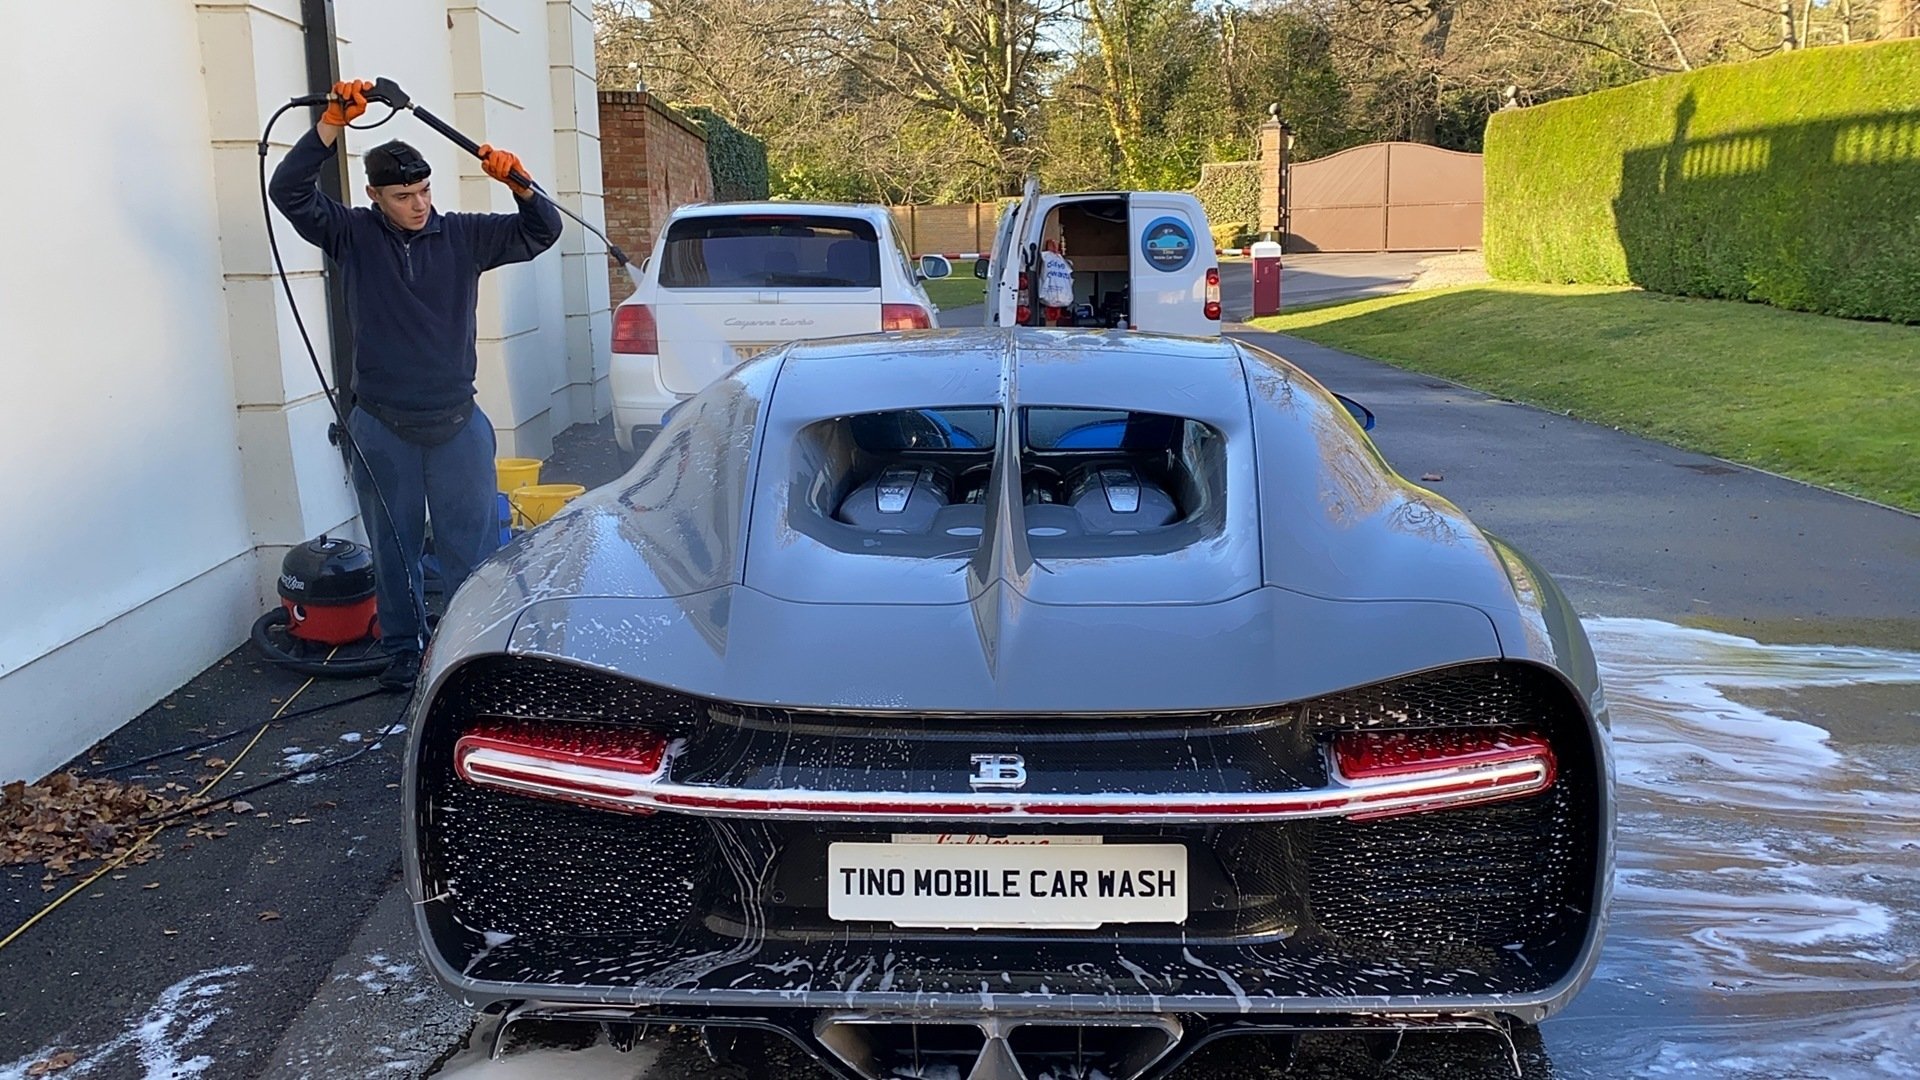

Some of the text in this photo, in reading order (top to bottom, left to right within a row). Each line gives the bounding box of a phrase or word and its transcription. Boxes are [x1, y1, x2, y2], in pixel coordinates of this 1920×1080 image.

[724, 317, 776, 329] Cayenne
[840, 868, 1175, 897] TINO MOBILE CAR WASH
